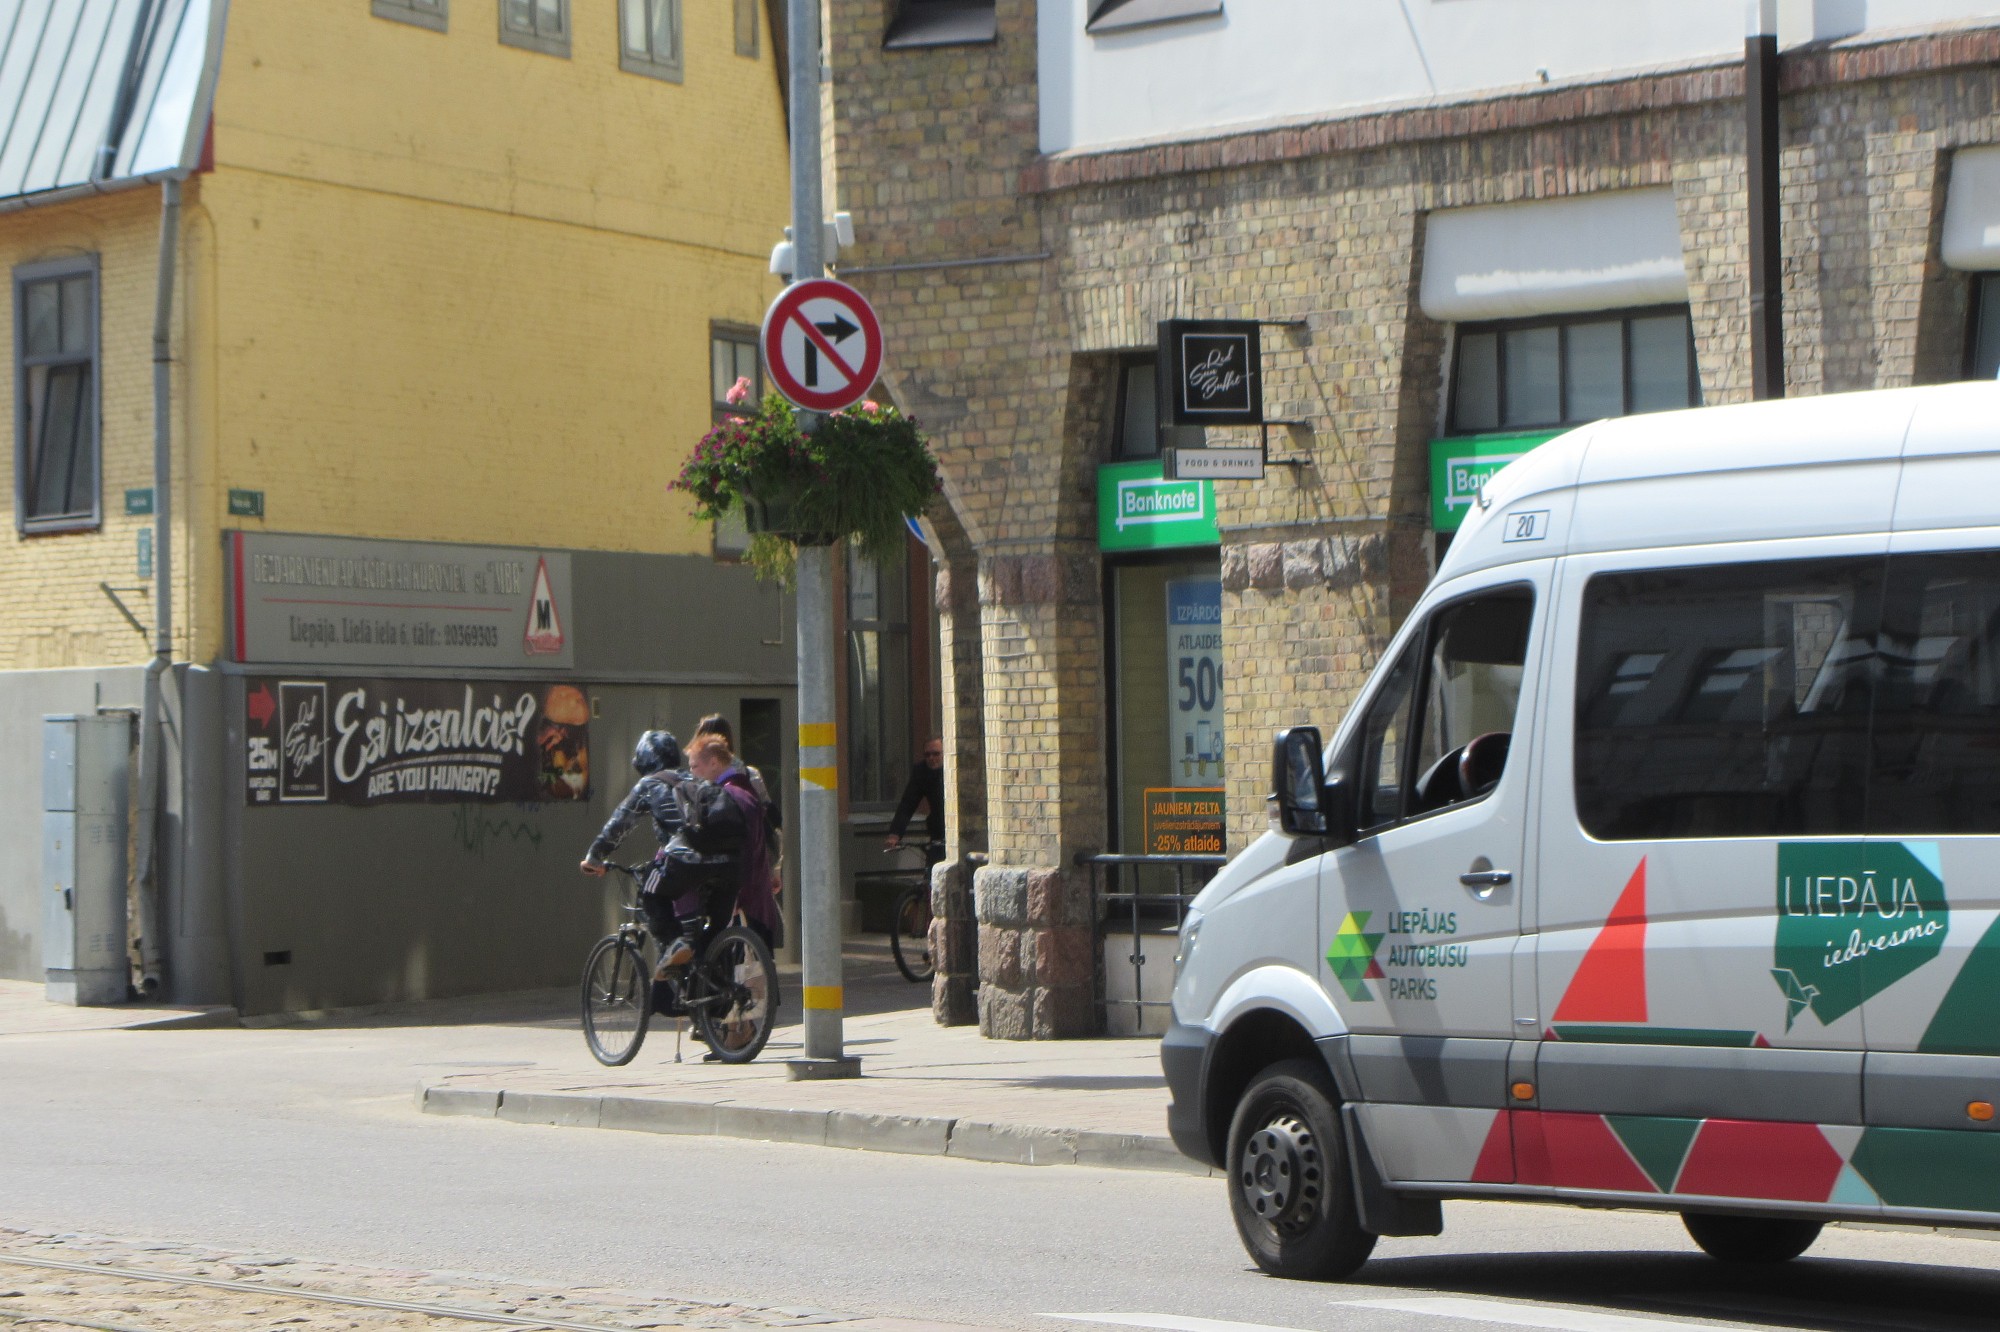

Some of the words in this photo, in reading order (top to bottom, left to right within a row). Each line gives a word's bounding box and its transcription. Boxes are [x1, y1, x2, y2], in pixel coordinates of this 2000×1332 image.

[1185, 458, 1209, 468] FOOD
[1213, 459, 1218, 468] &
[1222, 458, 1254, 468] DRINKS
[1125, 489, 1196, 513] Banknote
[1516, 515, 1535, 538] 20
[537, 600, 551, 630] M
[375, 620, 397, 645] iela
[1178, 656, 1223, 712] 50
[395, 684, 537, 756] izsalcis?
[367, 770, 395, 798] ARE
[395, 767, 427, 792] YOU
[429, 765, 501, 796] HUNGRY?
[1152, 802, 1192, 815] JAUNIEM
[1193, 802, 1221, 815] ZELTA
[1153, 835, 1181, 851] -25%
[1184, 835, 1221, 852] atlaide
[1784, 870, 1924, 919] LIEPĀJA
[1388, 907, 1457, 934] LIEPĀJAS
[1388, 945, 1468, 967] AUTOBUSU
[1823, 920, 1945, 968] iedvesmo
[1390, 977, 1437, 1001] PARKS
